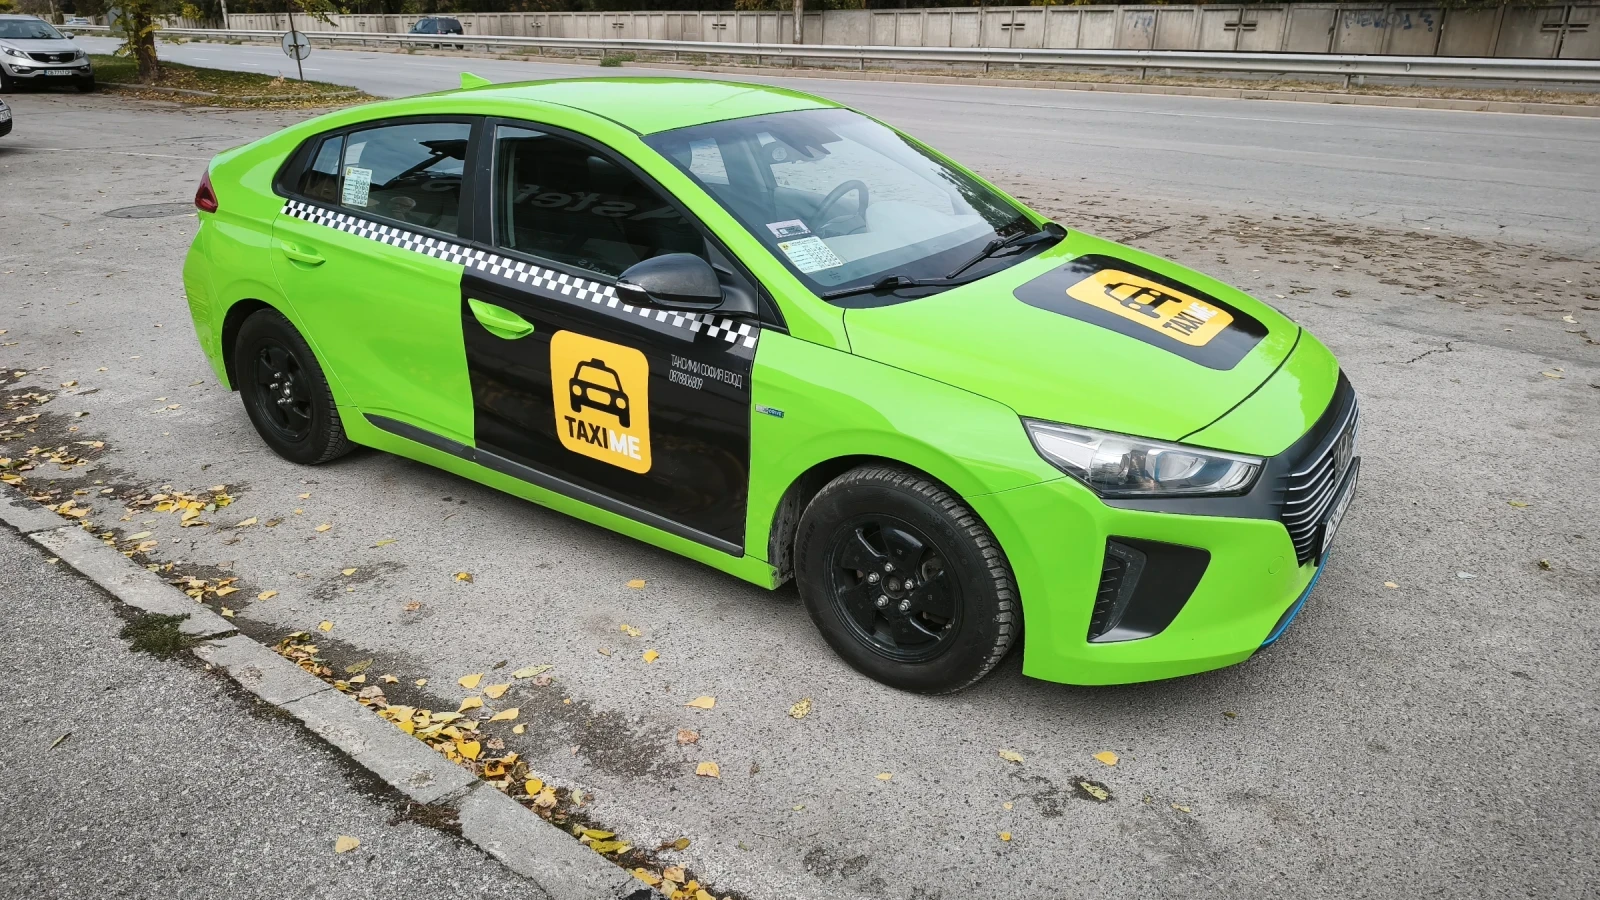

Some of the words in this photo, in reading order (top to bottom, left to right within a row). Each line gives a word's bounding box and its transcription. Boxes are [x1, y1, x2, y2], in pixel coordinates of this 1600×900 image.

[1162, 302, 1218, 336] TAXIME
[669, 369, 703, 390] 0878806809
[701, 363, 723, 381] СОФИЯ
[724, 370, 743, 389] ЕООД
[564, 415, 641, 460] TAXIME
